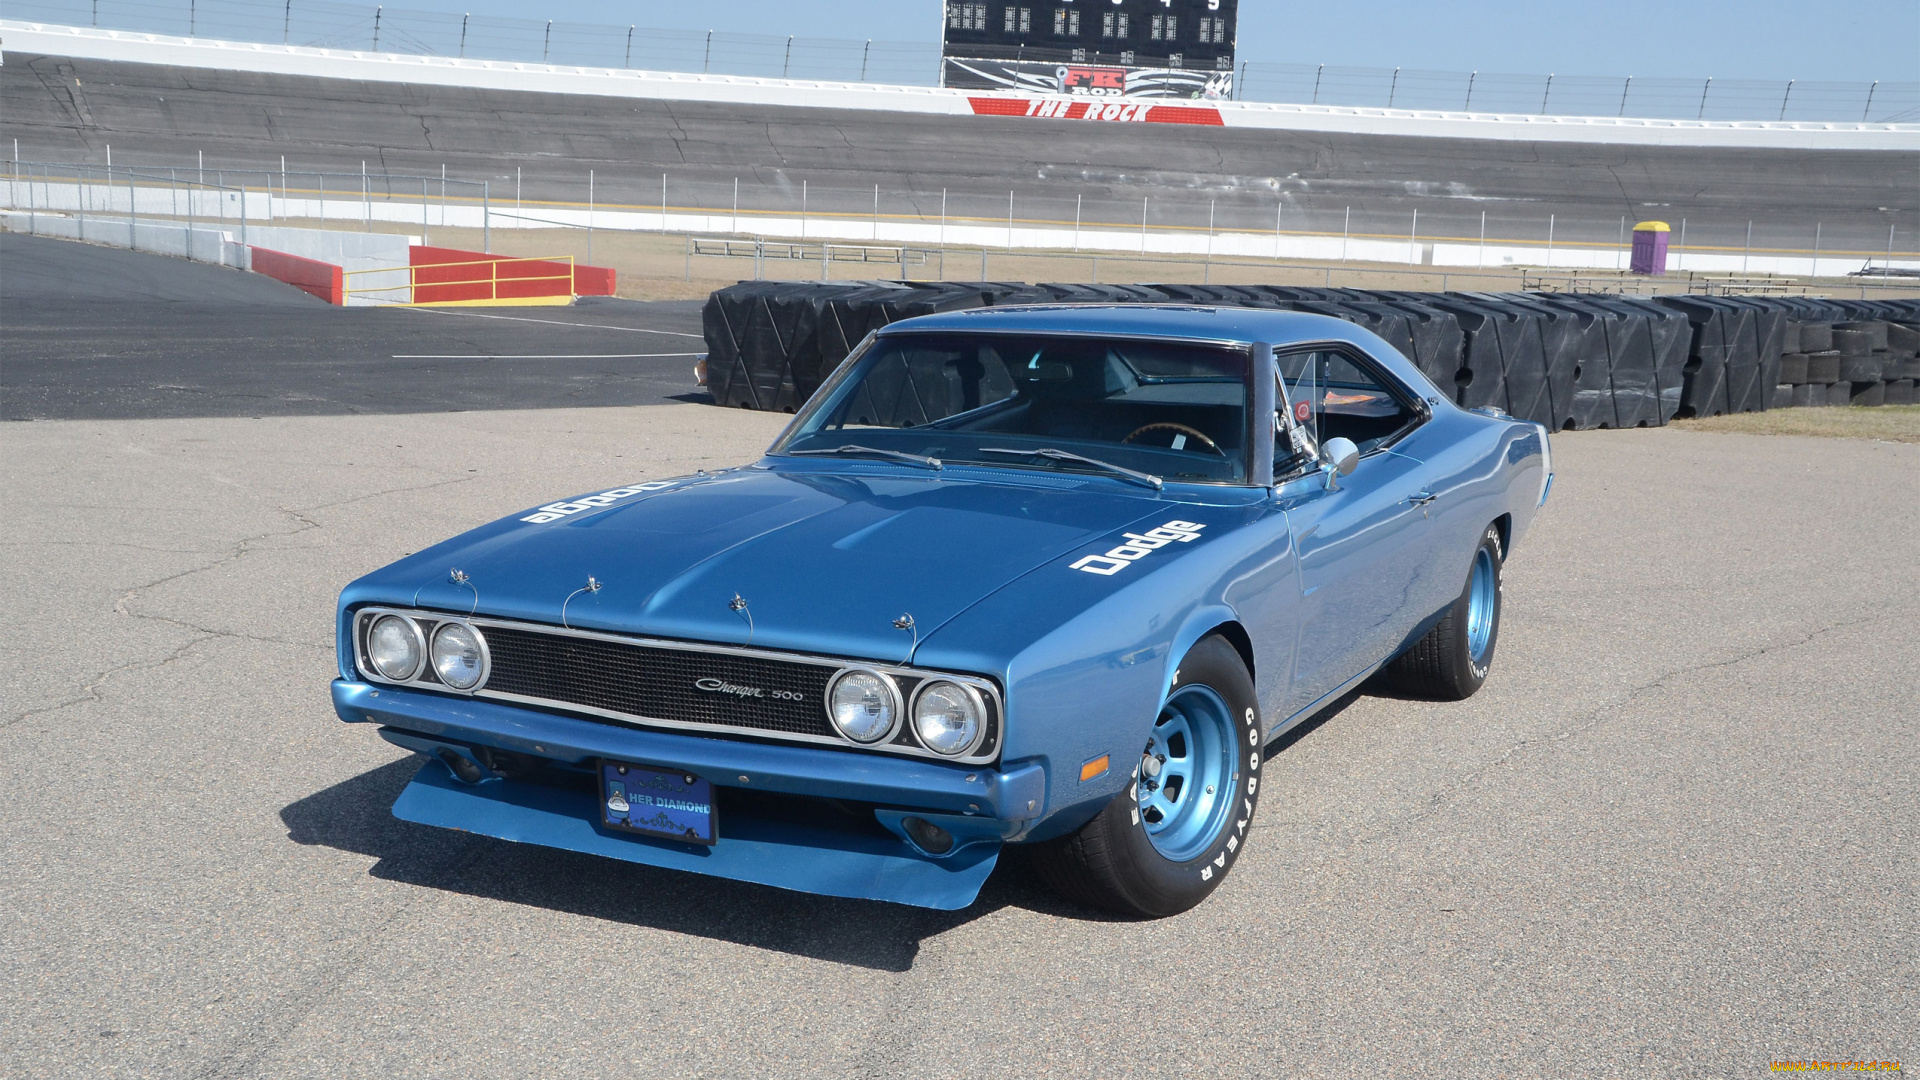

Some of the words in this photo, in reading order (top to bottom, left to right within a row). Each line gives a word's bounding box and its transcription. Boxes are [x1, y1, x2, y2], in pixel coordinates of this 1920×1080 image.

[1064, 69, 1122, 88] FK
[1071, 86, 1123, 97] ROD
[1025, 100, 1072, 117] THE
[1082, 103, 1154, 122] ROCK
[1068, 520, 1207, 576] Dodge
[695, 678, 764, 699] Charger
[771, 690, 803, 701] 500
[629, 793, 654, 806] HER
[656, 797, 711, 815] DIAMOND
[1201, 707, 1258, 881] GOODYEAR
